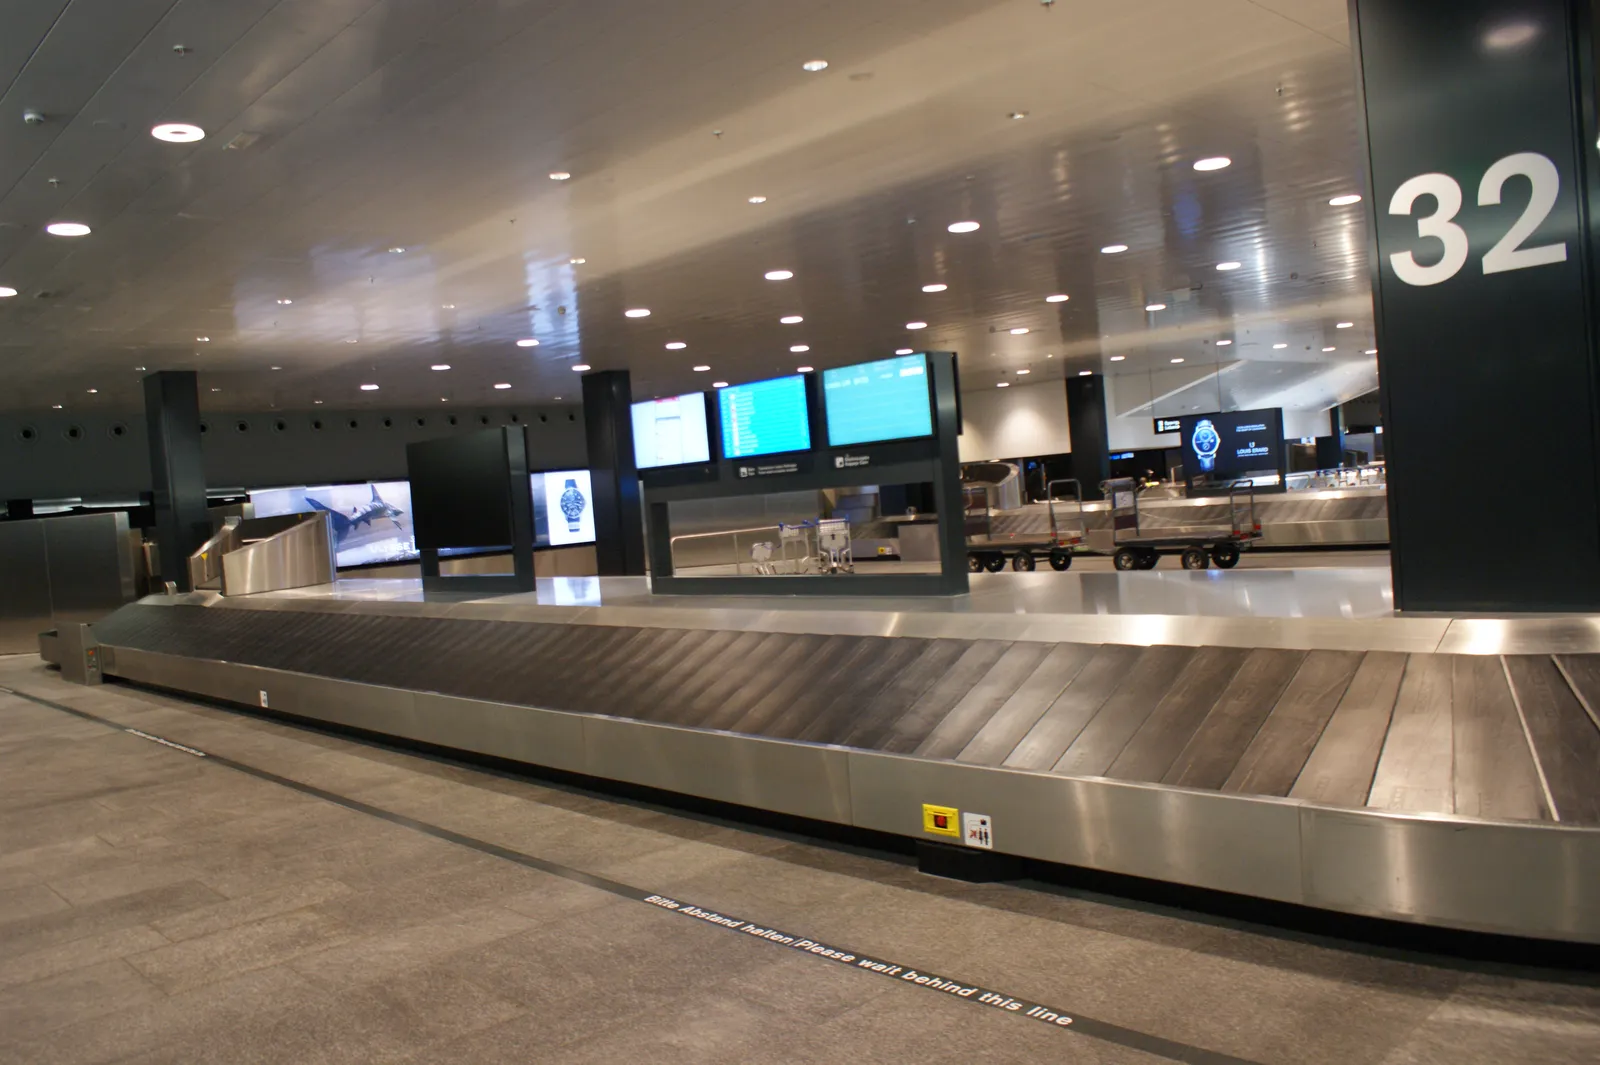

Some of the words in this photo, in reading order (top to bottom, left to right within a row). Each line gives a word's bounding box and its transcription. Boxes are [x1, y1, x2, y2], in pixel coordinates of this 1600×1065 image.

[1388, 152, 1567, 287] 32
[369, 541, 410, 554] ULYSE
[643, 895, 680, 909] Bitte
[678, 906, 745, 929] Abstand
[858, 958, 902, 976] wait
[901, 970, 978, 997] behind
[978, 992, 1023, 1011] this
[1026, 1005, 1073, 1026] line
